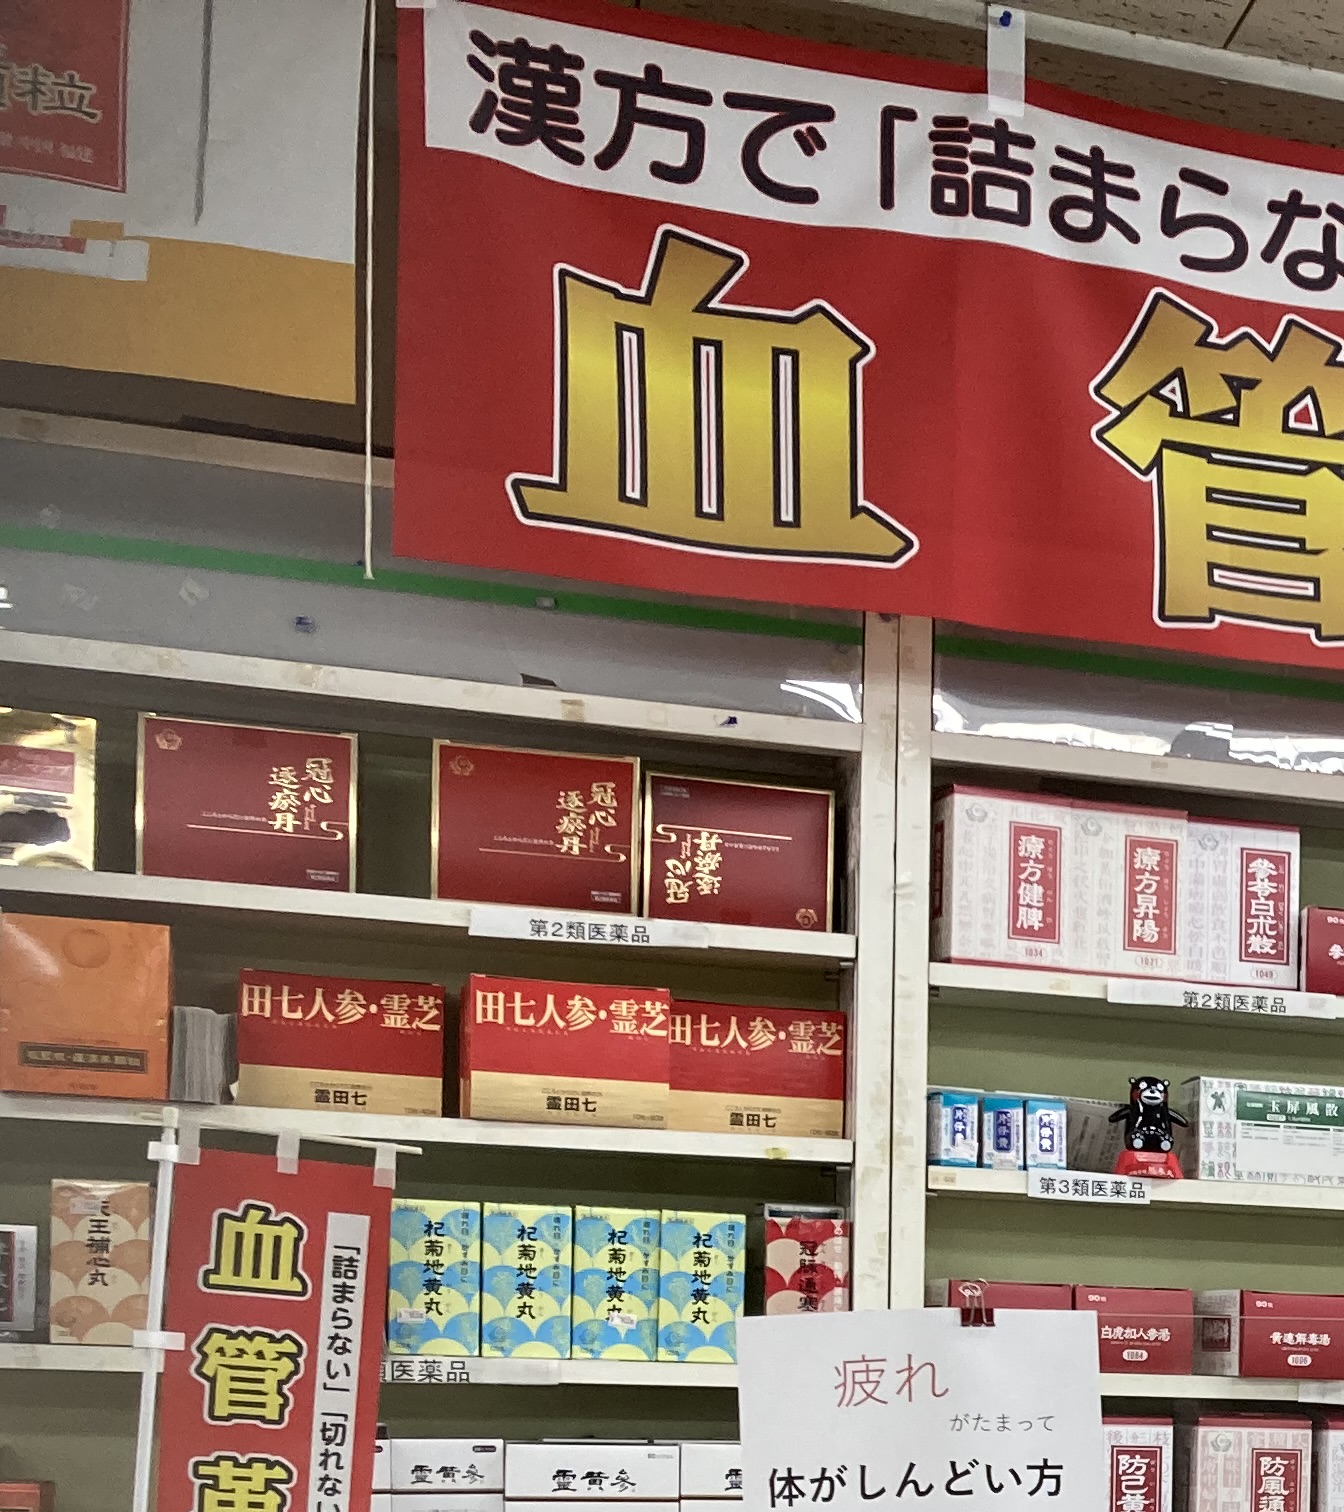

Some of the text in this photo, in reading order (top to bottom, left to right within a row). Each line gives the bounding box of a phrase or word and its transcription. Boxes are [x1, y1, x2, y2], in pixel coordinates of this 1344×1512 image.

[528, 918, 651, 945] 第2類医薬品
[1182, 990, 1288, 1014] 第2類医薬品
[1038, 1176, 1147, 1200] 第3類医薬品
[834, 1353, 950, 1408] 疲れ
[949, 1412, 1056, 1434] がたまって
[768, 1457, 1065, 1509] 体がしんどい方
